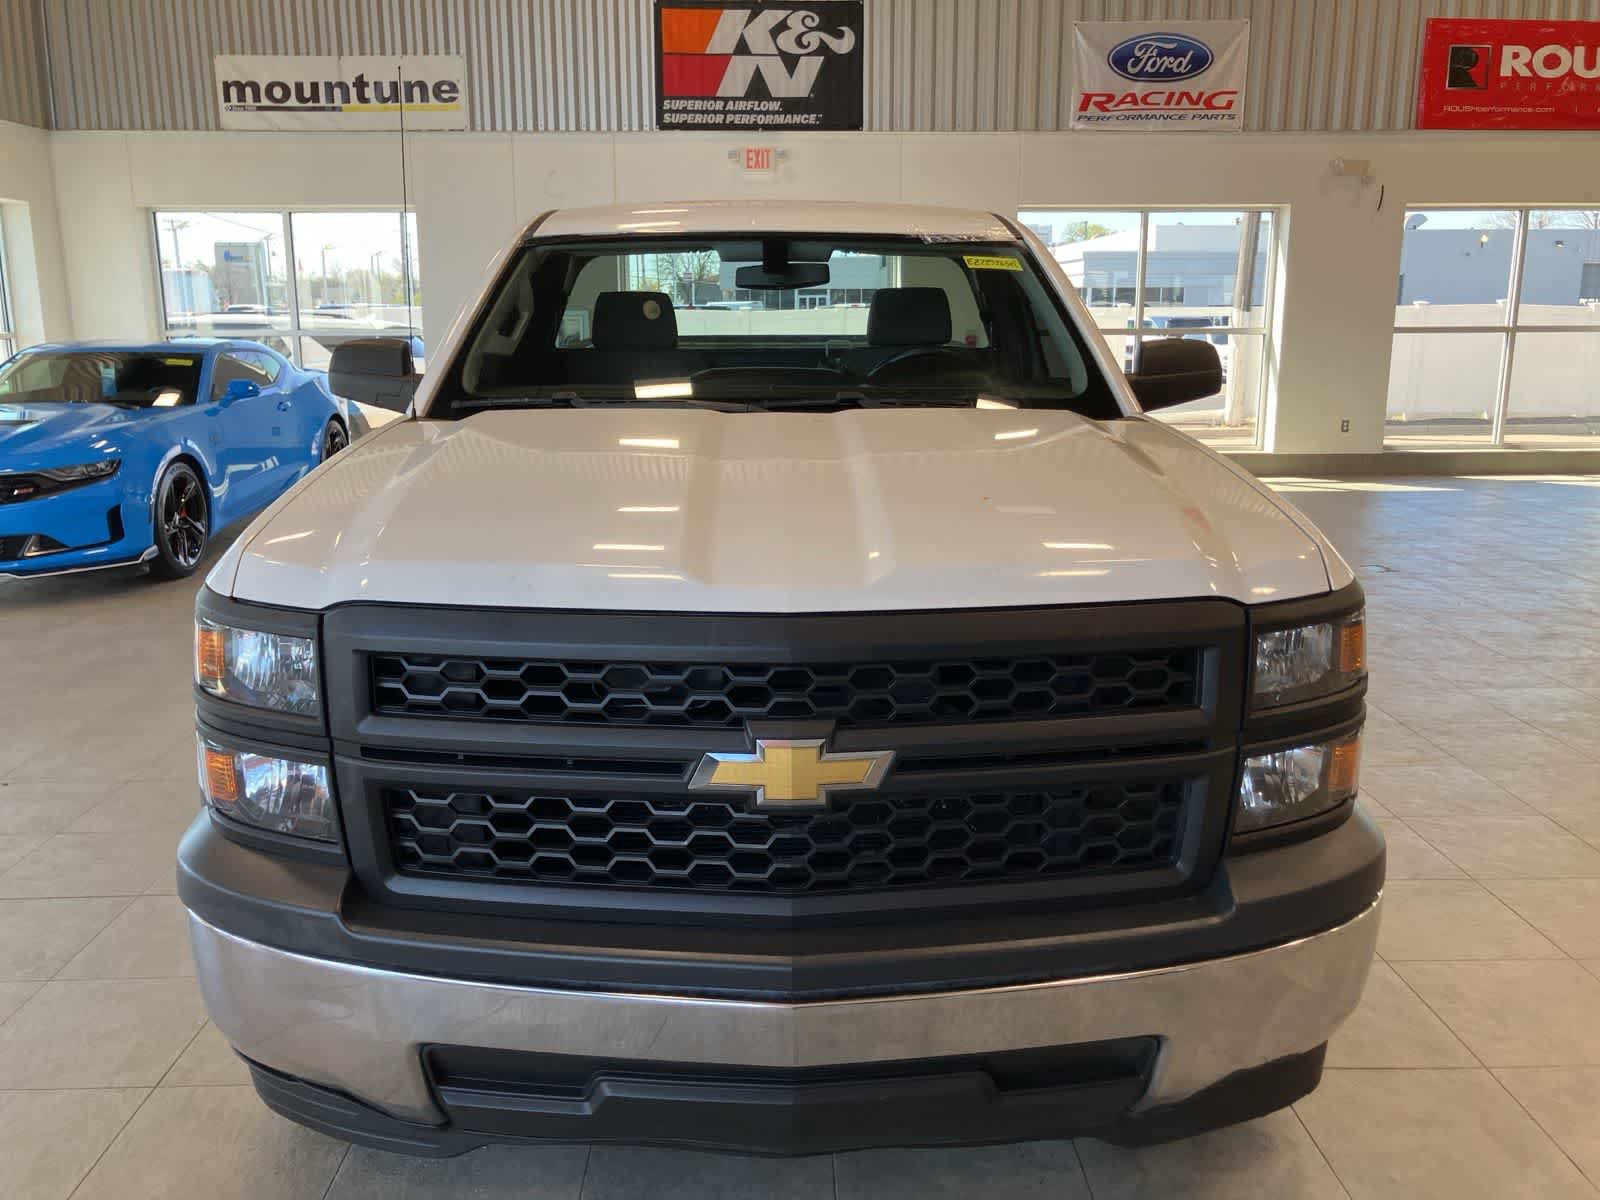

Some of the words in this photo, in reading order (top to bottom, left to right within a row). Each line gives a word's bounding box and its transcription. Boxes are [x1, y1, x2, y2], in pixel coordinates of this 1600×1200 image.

[1127, 41, 1194, 74] Ford
[222, 73, 460, 104] mountune
[663, 100, 724, 111] SUPERIOR
[725, 101, 783, 111] AIRFLOW.
[1078, 91, 1238, 112] RACING
[663, 113, 724, 124] SUPERIOR
[1077, 114, 1188, 122] PERFORMANCE
[1191, 113, 1236, 121] PARTS
[746, 148, 771, 169] EXIT
